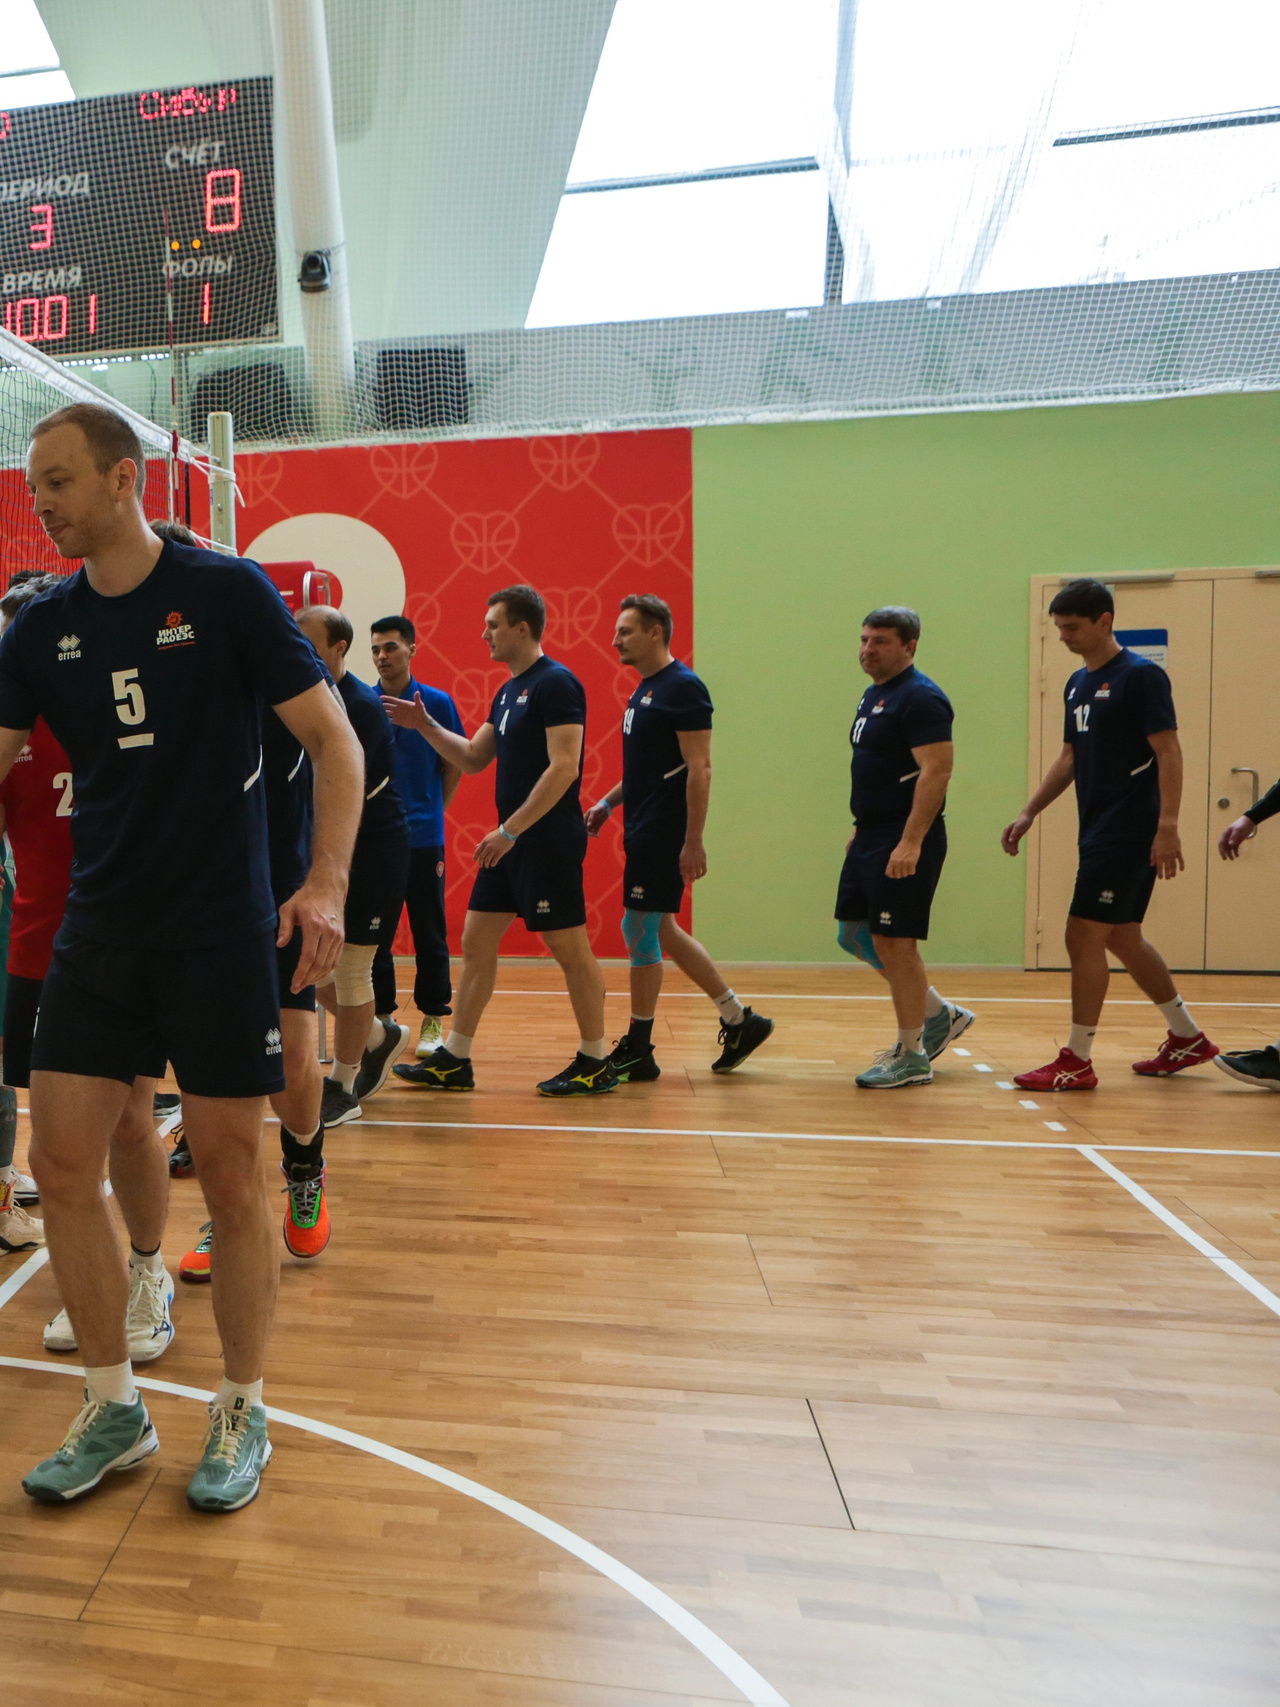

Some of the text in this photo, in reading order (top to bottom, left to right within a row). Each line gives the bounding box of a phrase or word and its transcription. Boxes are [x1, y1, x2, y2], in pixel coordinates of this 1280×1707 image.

[205, 168, 242, 233] 8
[30, 204, 54, 250] 3
[2, 265, 81, 293] ВРЕМЯ
[203, 282, 210, 325] 1
[158, 624, 192, 638] ИНТЕР
[58, 649, 81, 661] errea
[111, 668, 146, 725] 5
[623, 708, 635, 735] 19
[852, 717, 867, 744] 17
[1073, 704, 1090, 732] 12
